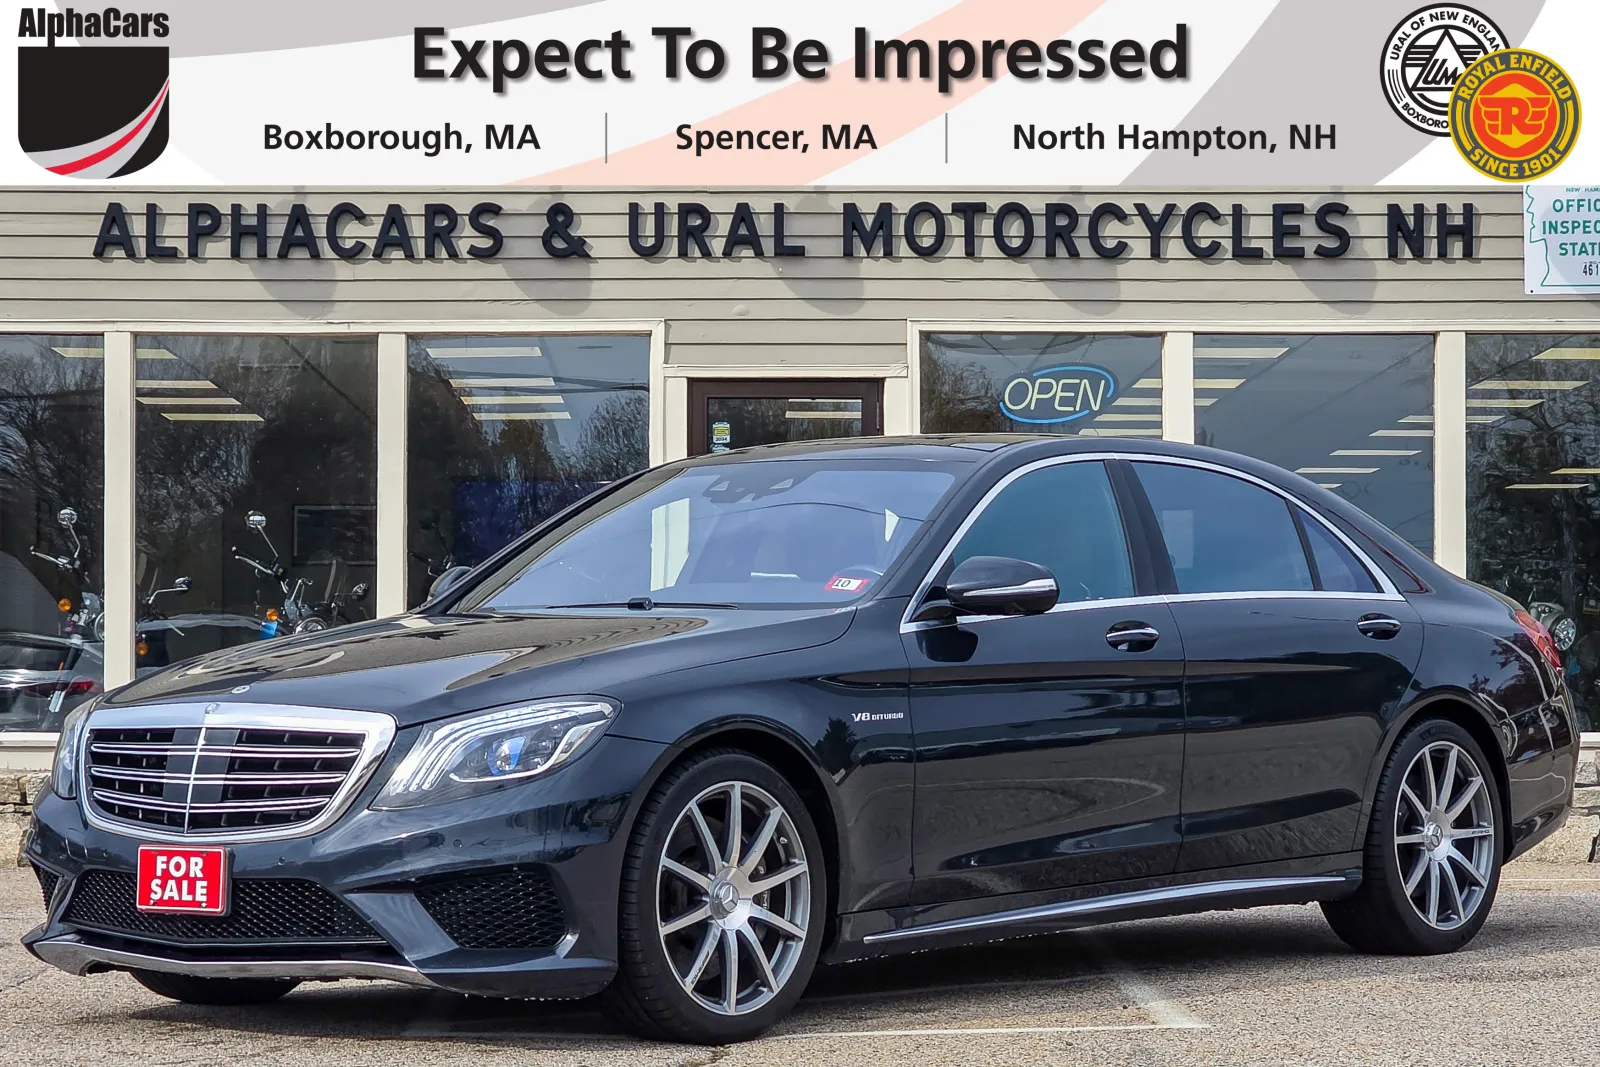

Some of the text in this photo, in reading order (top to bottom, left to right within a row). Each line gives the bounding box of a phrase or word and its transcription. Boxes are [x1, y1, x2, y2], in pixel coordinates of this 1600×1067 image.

[93, 201, 1474, 259] ALPHACARS & URAL MOTORCYCLES NH
[1004, 378, 1105, 411] OPEN
[833, 579, 851, 588] 10
[851, 712, 870, 722] V8
[156, 855, 204, 878] FOR
[150, 878, 208, 902] SALE
